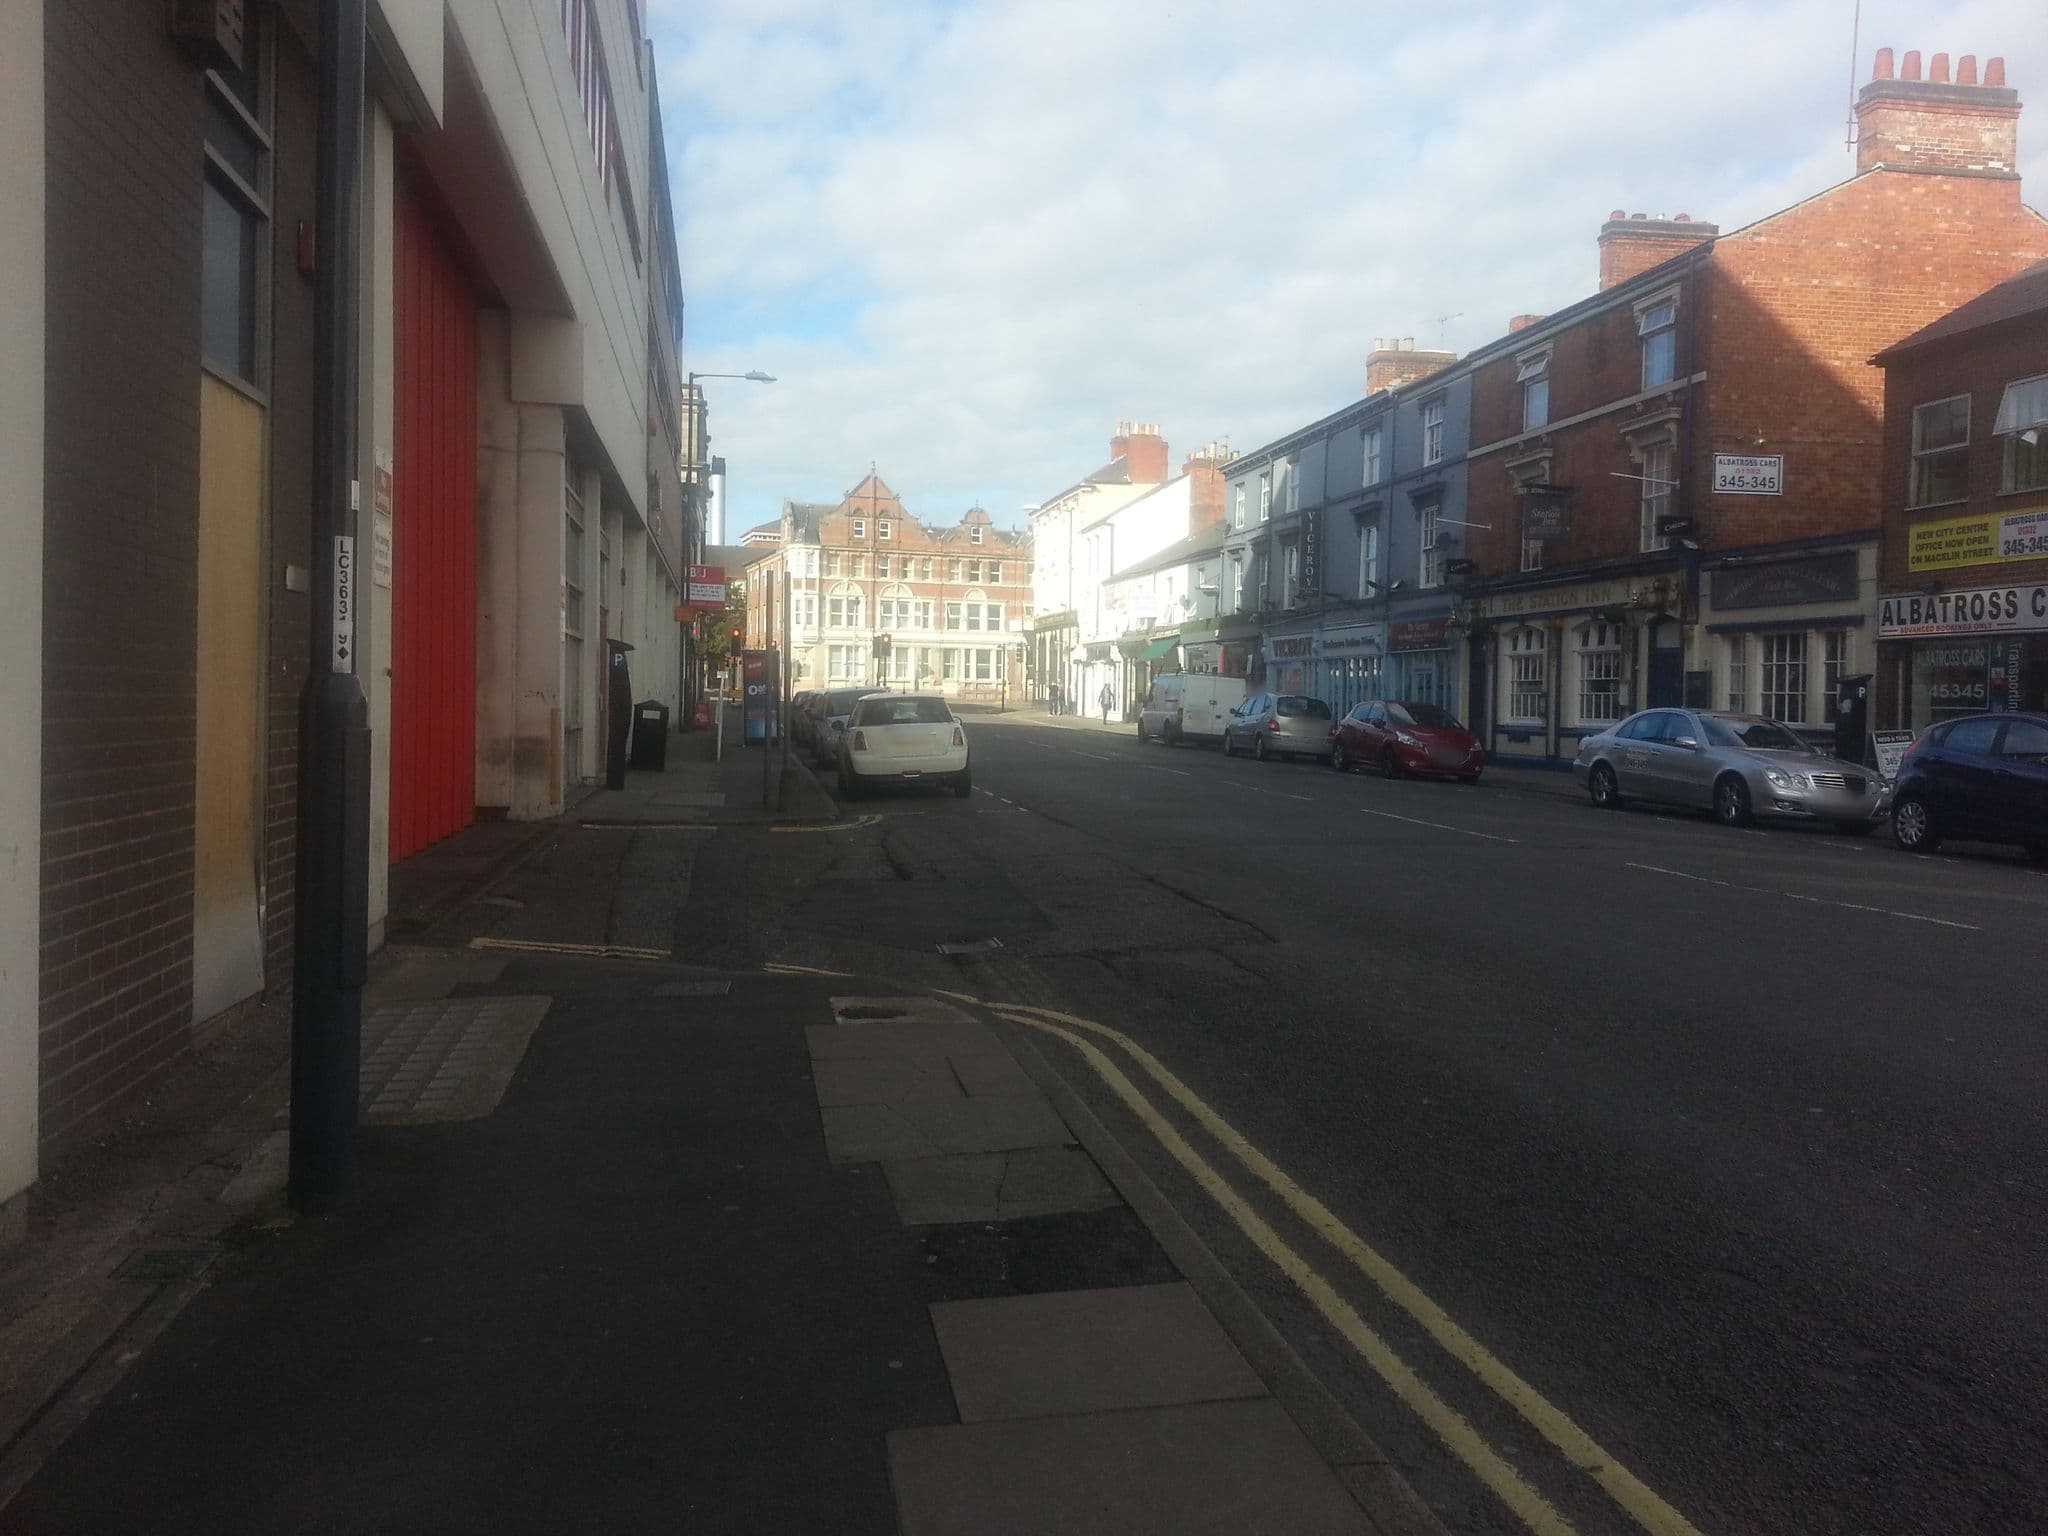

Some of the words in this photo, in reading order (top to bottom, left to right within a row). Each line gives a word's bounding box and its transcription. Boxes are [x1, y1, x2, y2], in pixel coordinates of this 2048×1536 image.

[1718, 458, 1758, 467] ALBATROSS
[1760, 459, 1777, 467] CARS
[1719, 475, 1776, 488] 345-345
[1916, 531, 1934, 540] NEW
[1935, 528, 1954, 538] CITY
[1956, 523, 1989, 535] CENTRE
[1305, 512, 1315, 586] VICEROY
[1915, 541, 1943, 552] OFFICE
[1944, 539, 1965, 549] NOW
[1966, 536, 1989, 546] OPEN
[1911, 555, 1923, 564] ON
[1924, 551, 1961, 563] MACKLIN
[1962, 547, 1994, 560] STREET
[1529, 591, 1578, 609] STATION
[1584, 583, 1611, 603] INN
[1881, 590, 2018, 626] ALBATROSS
[1900, 625, 1934, 634] ADVANCED
[1936, 624, 1973, 633] BOOKINGS
[1974, 622, 1993, 631] ONLY
[614, 653, 622, 665] P
[1961, 648, 1985, 667] CARS
[1858, 686, 1866, 698] P
